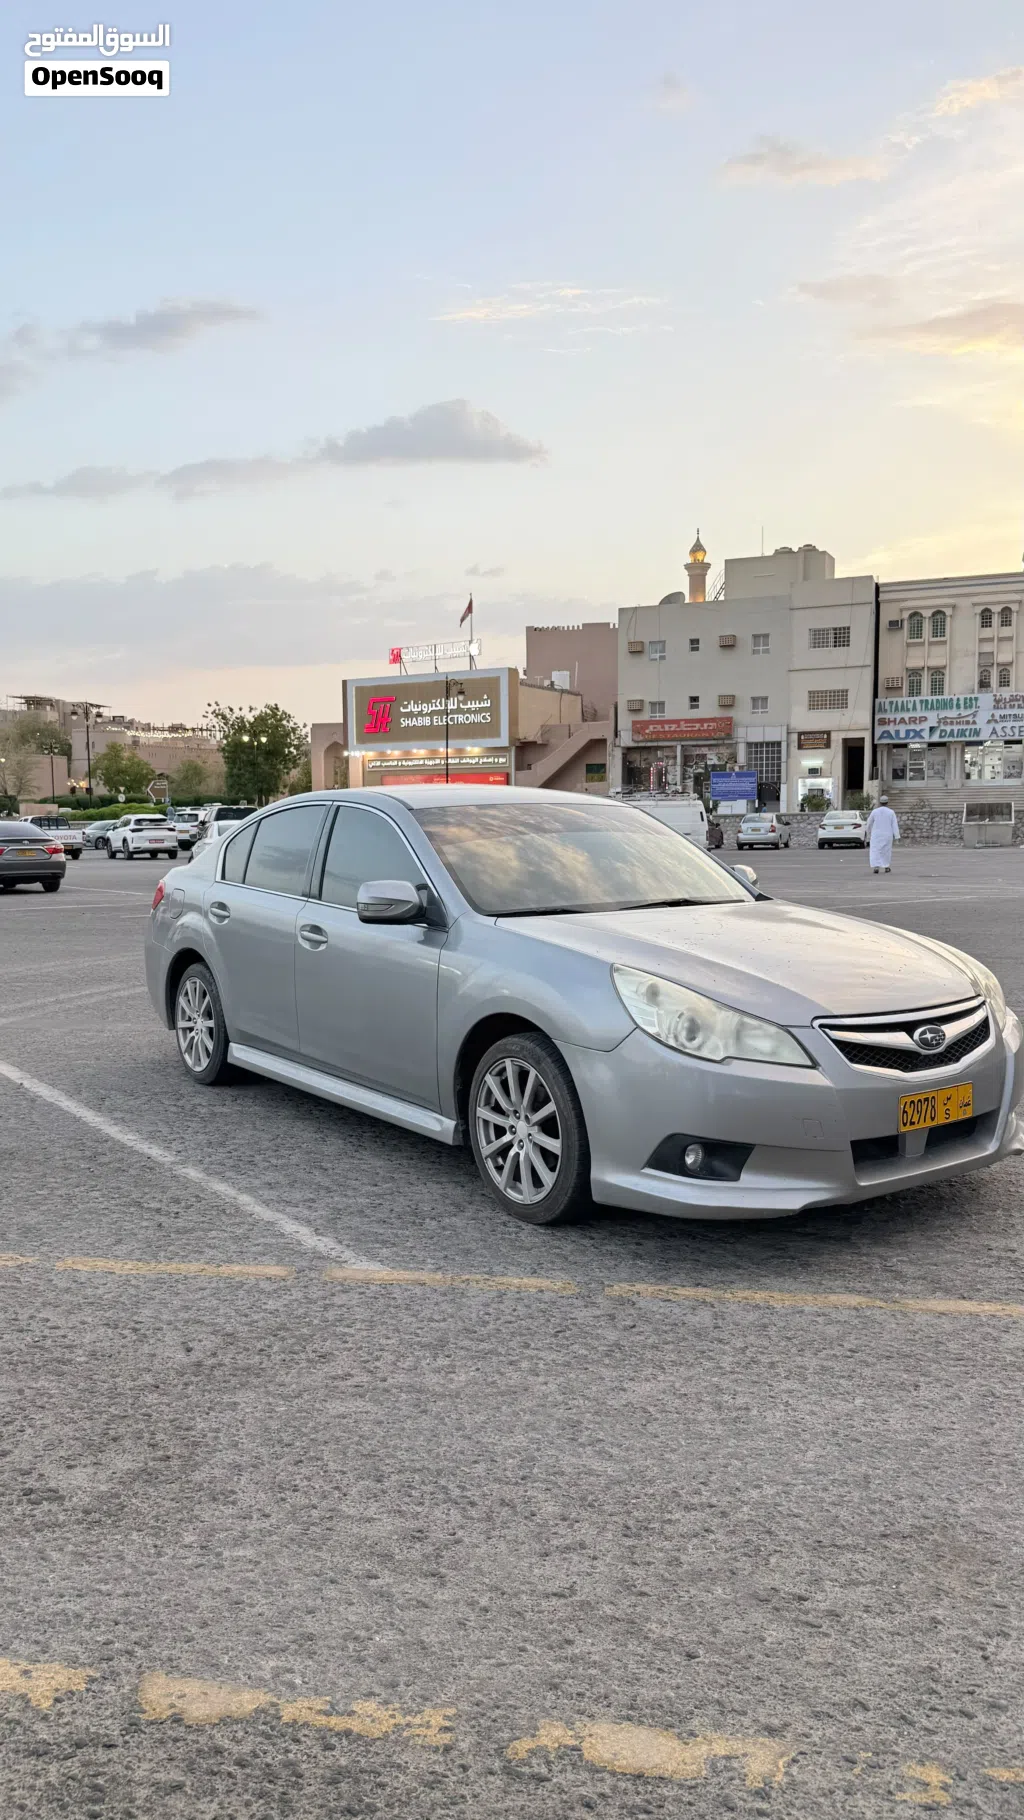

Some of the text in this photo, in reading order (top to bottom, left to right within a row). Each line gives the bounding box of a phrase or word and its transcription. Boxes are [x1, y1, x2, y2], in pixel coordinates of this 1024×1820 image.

[460, 694, 491, 711] شبيب
[877, 701, 888, 713] AL
[919, 697, 954, 711] TRADING
[955, 698, 962, 710] &
[963, 696, 980, 709] EST.
[400, 712, 491, 727] SHABIB ELECTRONICS
[877, 715, 928, 726] SHARP
[936, 718, 977, 727] TOSHIBA
[877, 728, 926, 740] AUX
[938, 727, 981, 738] DAIKIN
[901, 1096, 936, 1127] 62978
[944, 1108, 951, 1120] S
